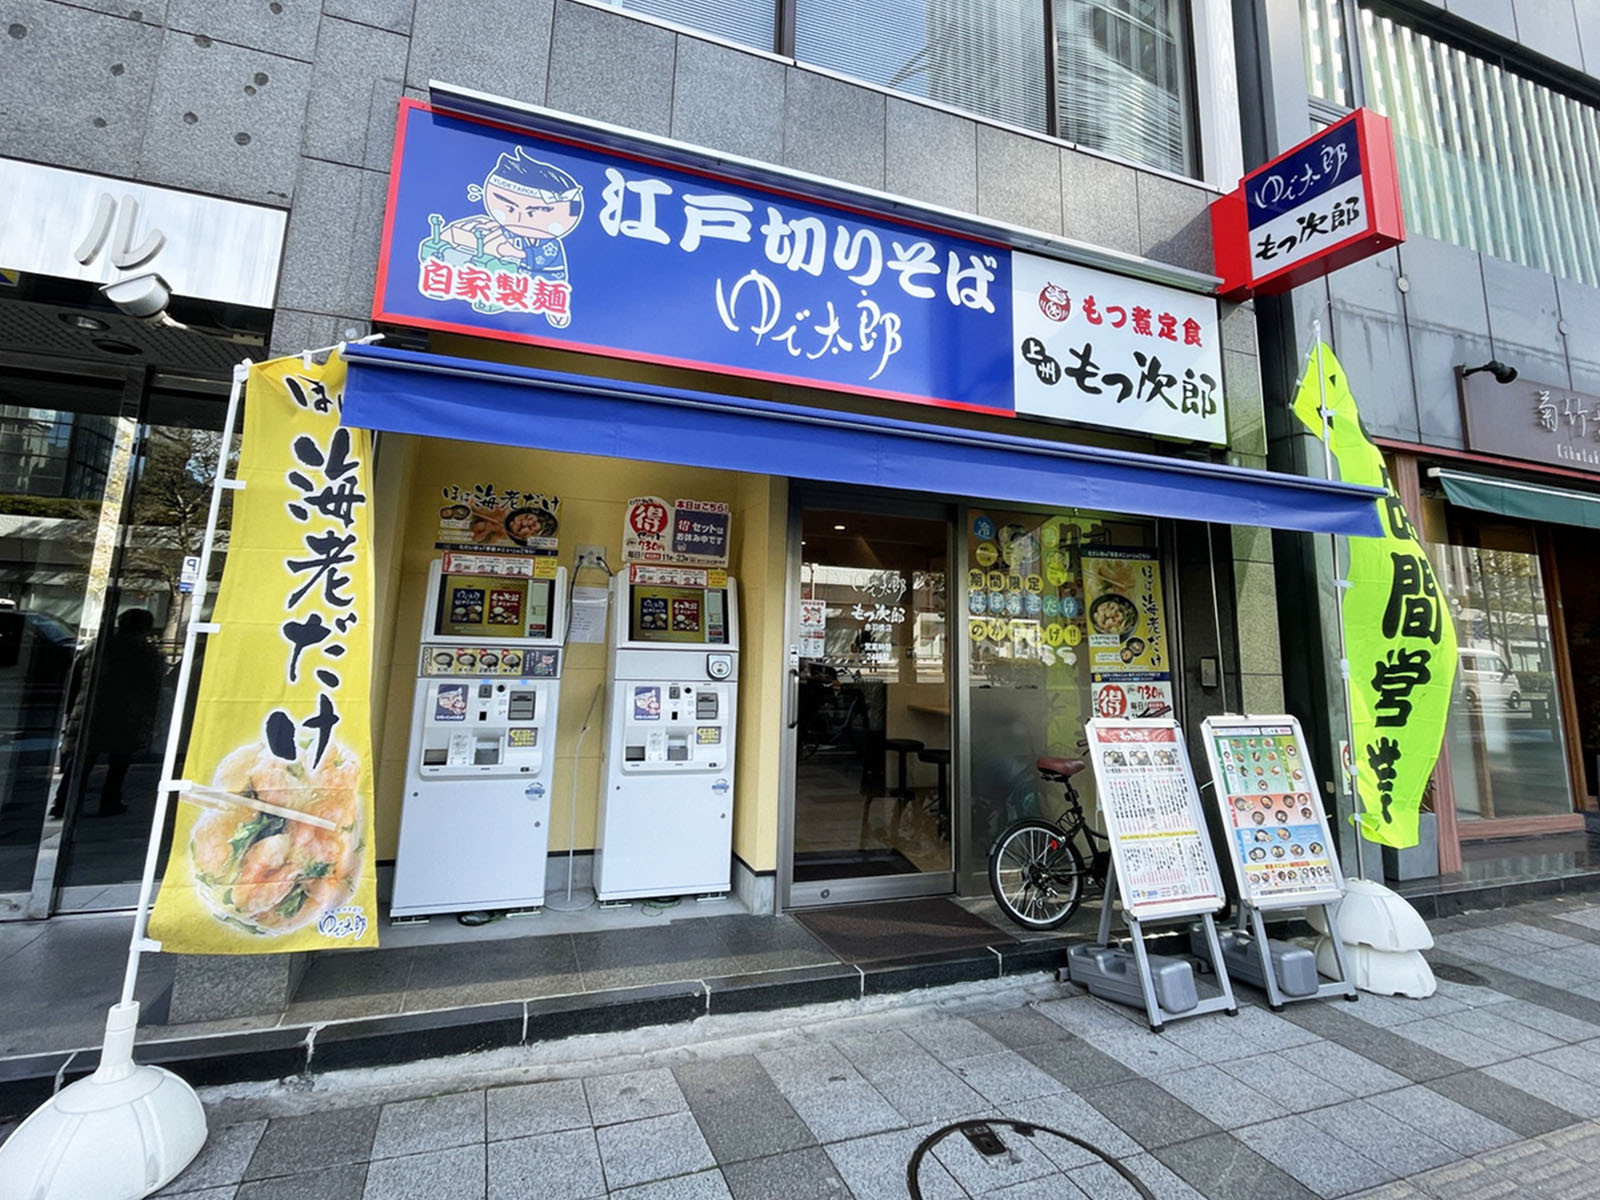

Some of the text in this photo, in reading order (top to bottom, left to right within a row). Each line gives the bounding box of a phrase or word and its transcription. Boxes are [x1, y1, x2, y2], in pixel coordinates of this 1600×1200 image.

[74, 192, 167, 271] ル
[599, 167, 998, 314] 江戸切りそば
[1256, 196, 1360, 260] もつ次郎
[421, 260, 568, 315] 自家製麺
[715, 269, 902, 381] ゆで太郎
[1082, 295, 1203, 348] もつ煮定食
[1023, 338, 1060, 385] 上州
[1064, 342, 1217, 419] もつ次郎
[634, 505, 663, 532] 得
[265, 427, 367, 771] 海老だけ
[850, 603, 906, 623] もつ次郎
[1100, 689, 1122, 715] 得
